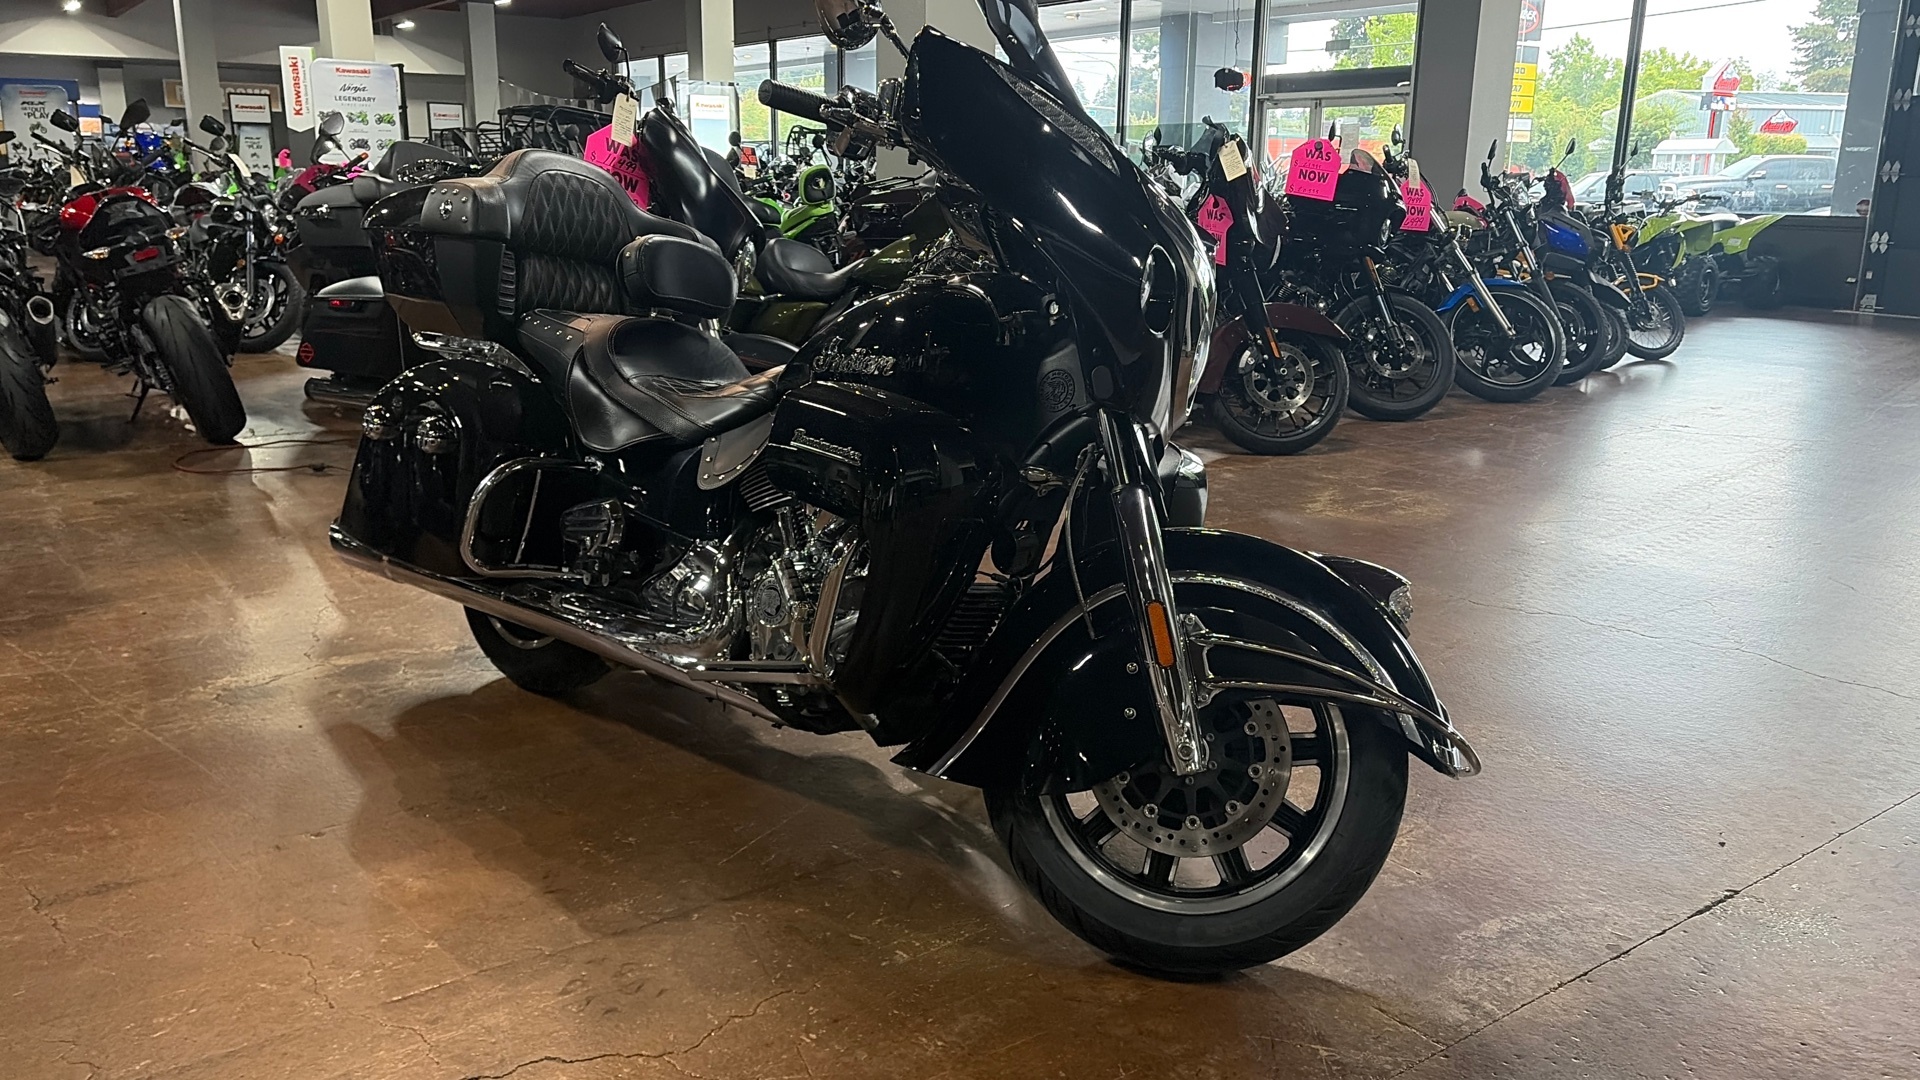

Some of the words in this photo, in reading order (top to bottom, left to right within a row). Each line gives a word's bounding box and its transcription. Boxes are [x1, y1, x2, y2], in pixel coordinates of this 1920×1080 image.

[335, 67, 371, 75] Kawasaki
[288, 56, 303, 116] Kawasaki
[339, 83, 369, 94] Ninja
[334, 95, 376, 103] LEGENDARY
[606, 137, 640, 162] WAS
[1305, 148, 1332, 161] WAS
[590, 150, 597, 162] $
[1298, 169, 1330, 184] NOW
[1406, 187, 1425, 197] WAS
[1206, 209, 1226, 222] WAS
